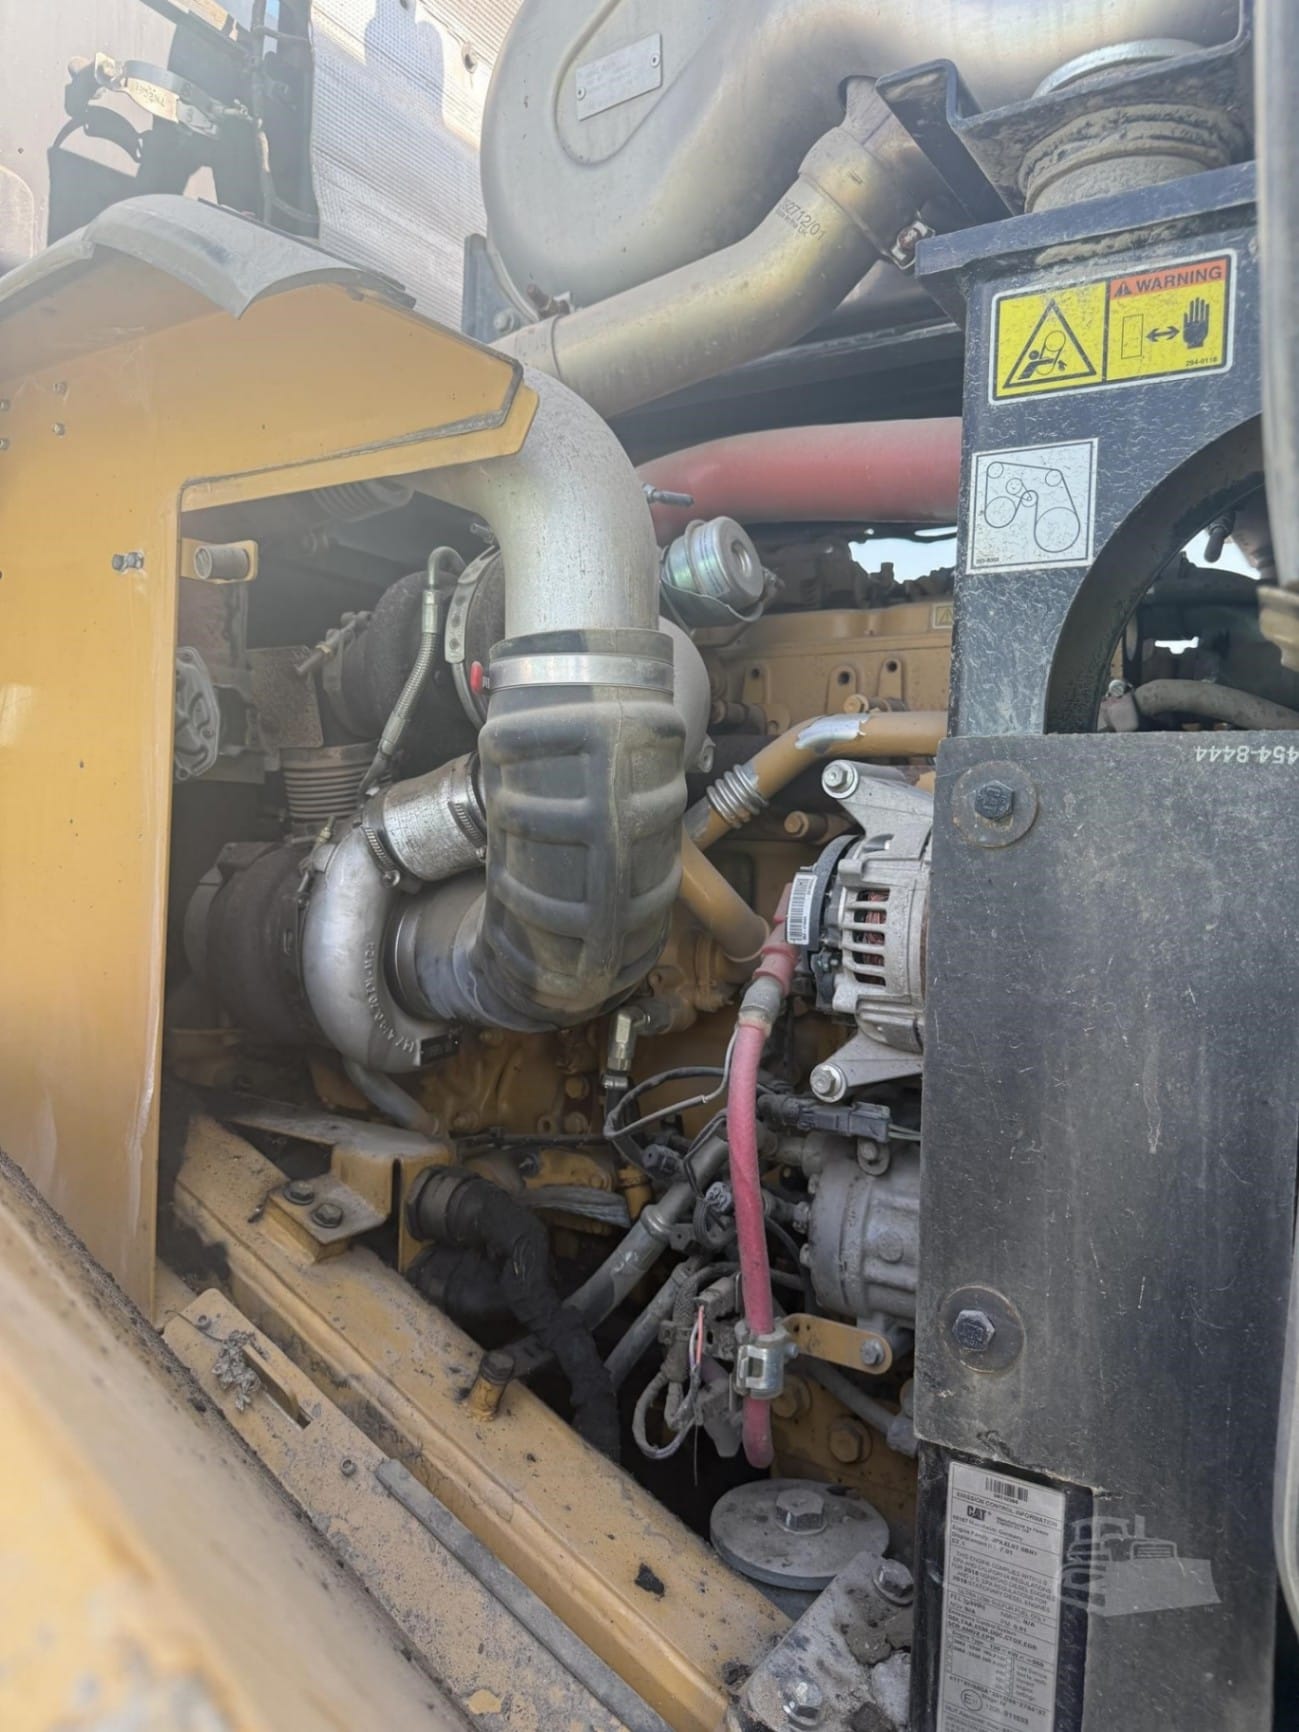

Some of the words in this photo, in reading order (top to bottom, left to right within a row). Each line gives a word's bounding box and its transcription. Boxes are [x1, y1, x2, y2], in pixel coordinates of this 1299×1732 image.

[1136, 266, 1222, 293] WARNING
[1193, 745, 1299, 766] 454-8444
[967, 1504, 986, 1521] CAT
